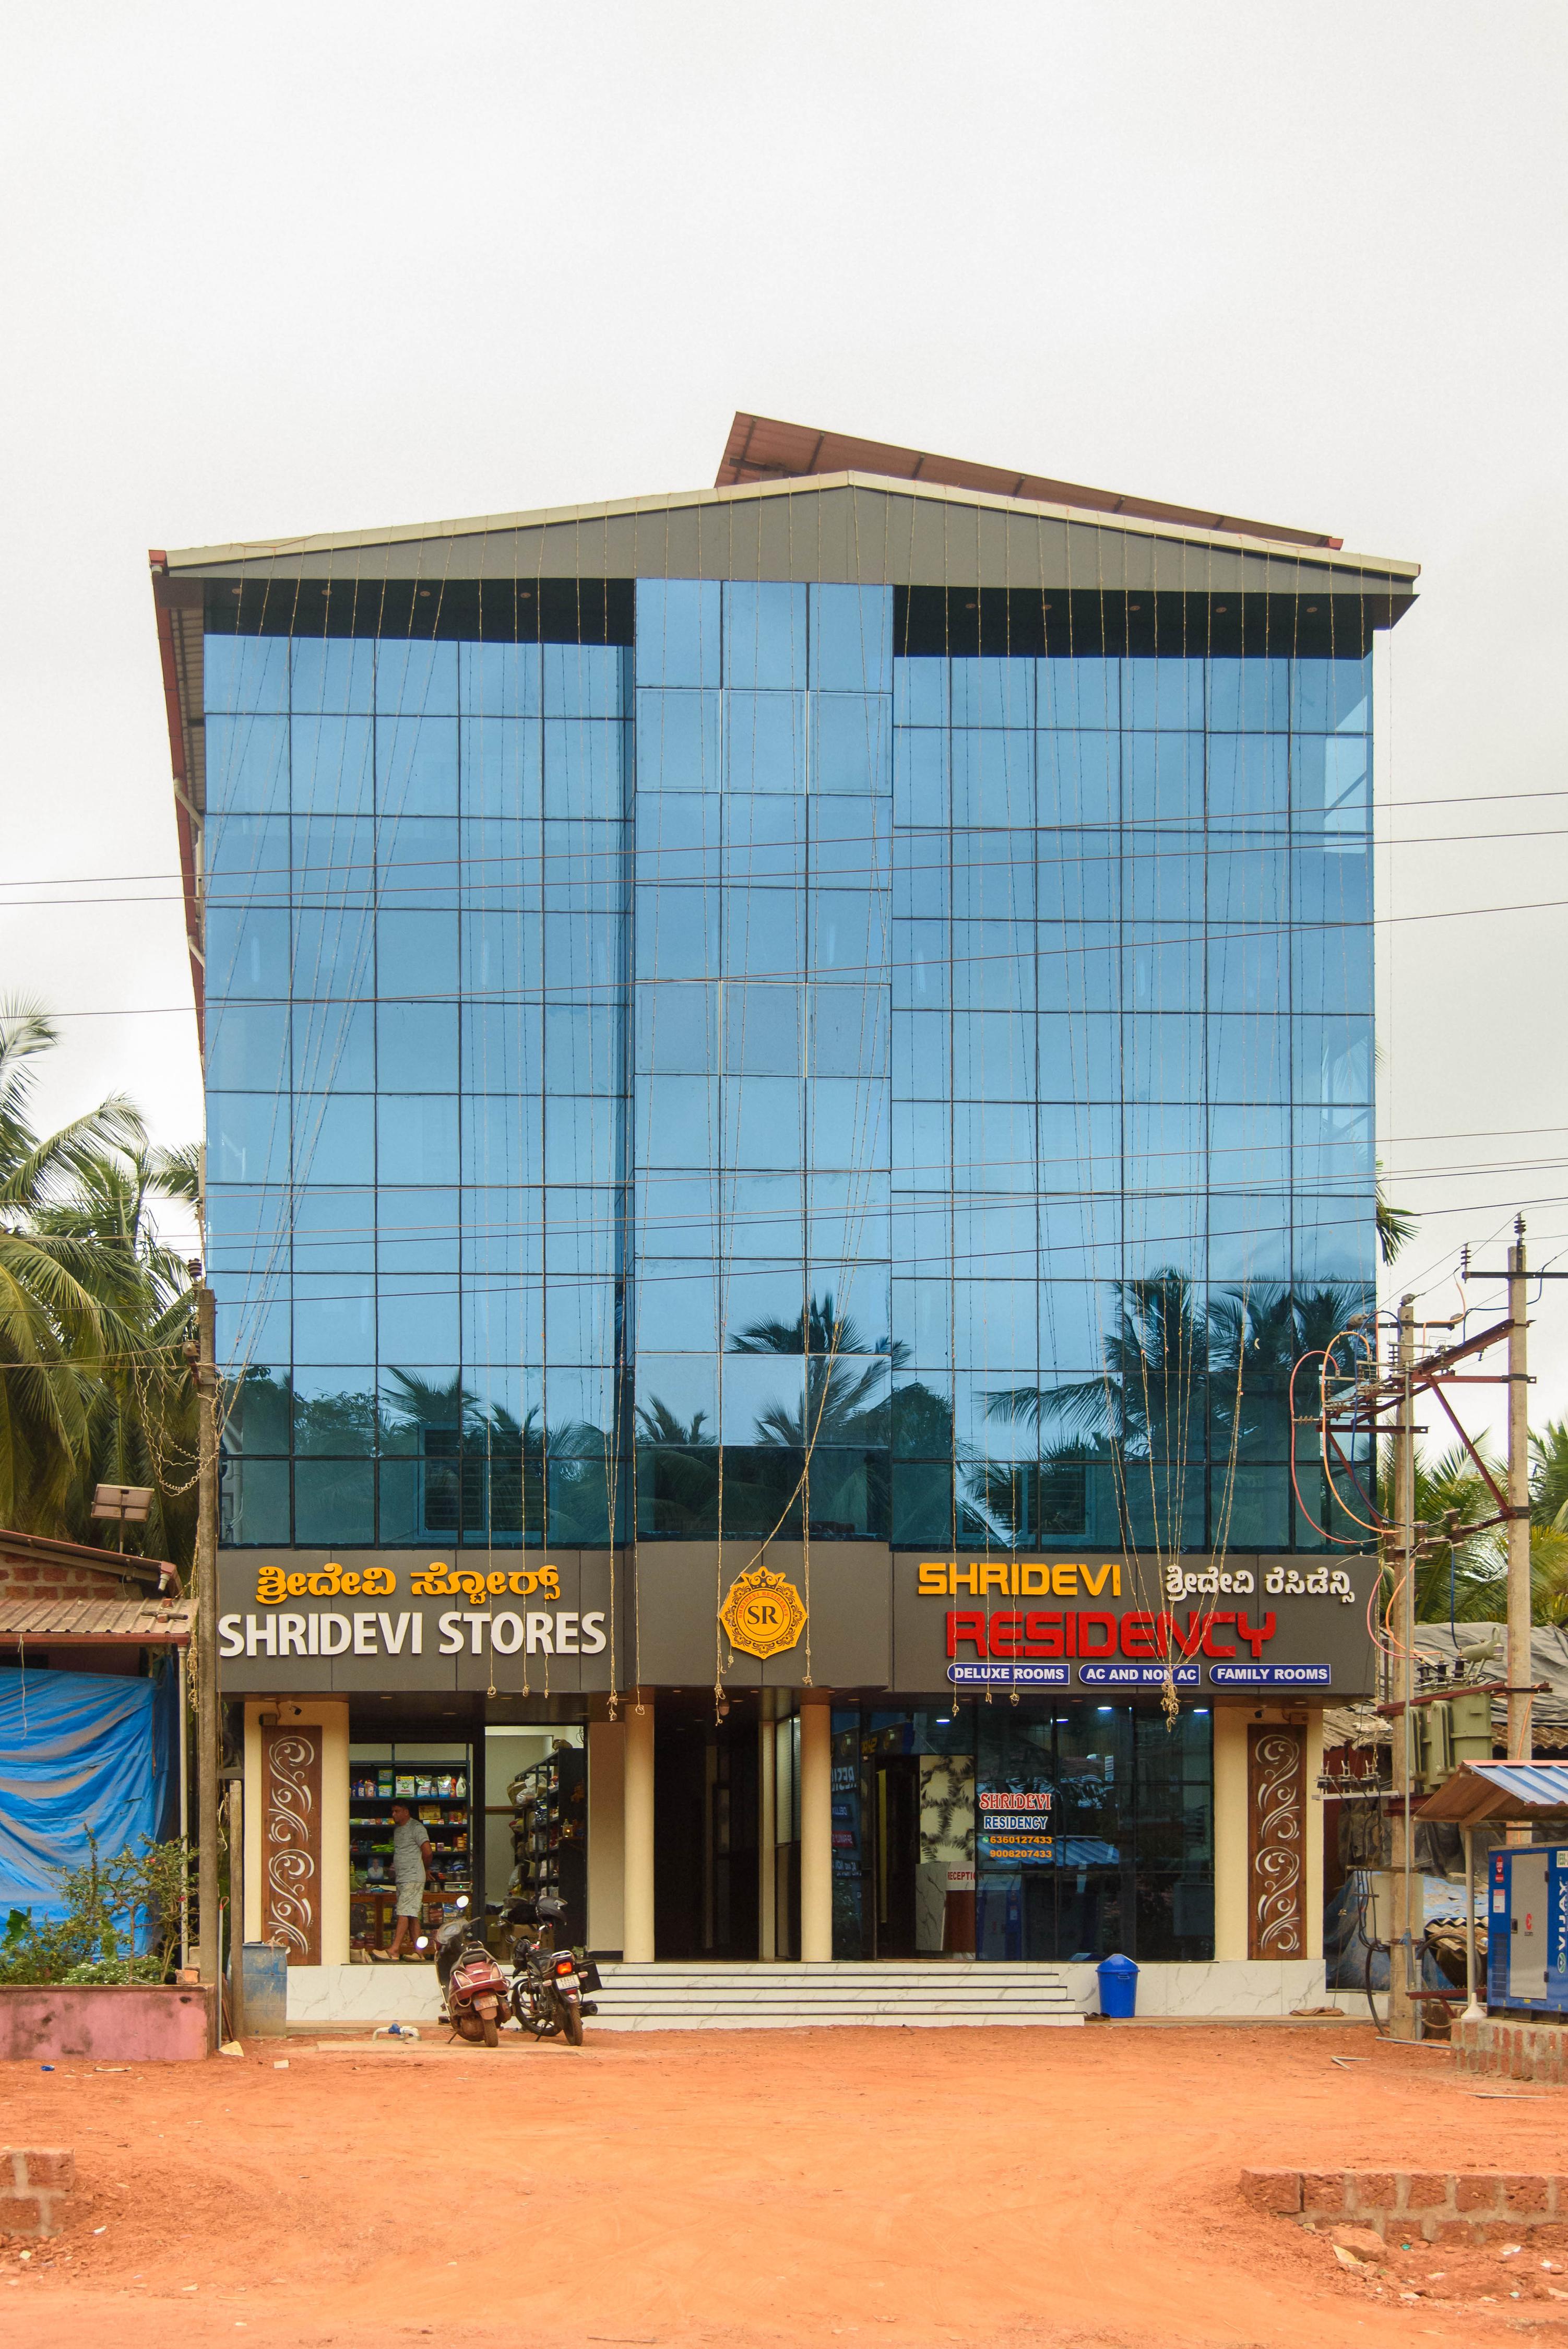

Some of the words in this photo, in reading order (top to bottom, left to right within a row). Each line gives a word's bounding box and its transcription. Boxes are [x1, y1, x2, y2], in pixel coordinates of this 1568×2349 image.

[918, 1562, 1122, 1597] SHRIDEVI
[747, 1605, 779, 1624] SR
[218, 1611, 422, 1657] SHRIDEVI
[438, 1611, 607, 1654] STORES
[946, 1611, 1276, 1657] RESIDENCY
[955, 1667, 1010, 1679] DELUXE
[1014, 1668, 1065, 1680] ROOMS
[1086, 1668, 1106, 1679] AC
[1109, 1669, 1139, 1680] AND
[1142, 1669, 1172, 1680] NON
[1177, 1669, 1197, 1680] AC
[1217, 1668, 1270, 1680] FAMILY
[1274, 1668, 1328, 1680] ROOMS
[979, 1792, 1052, 1810] SHRIDEVI
[983, 1816, 1048, 1830] RESIDENCY
[990, 1836, 1052, 1844] 6360127433
[990, 1849, 1052, 1858] 9008207433
